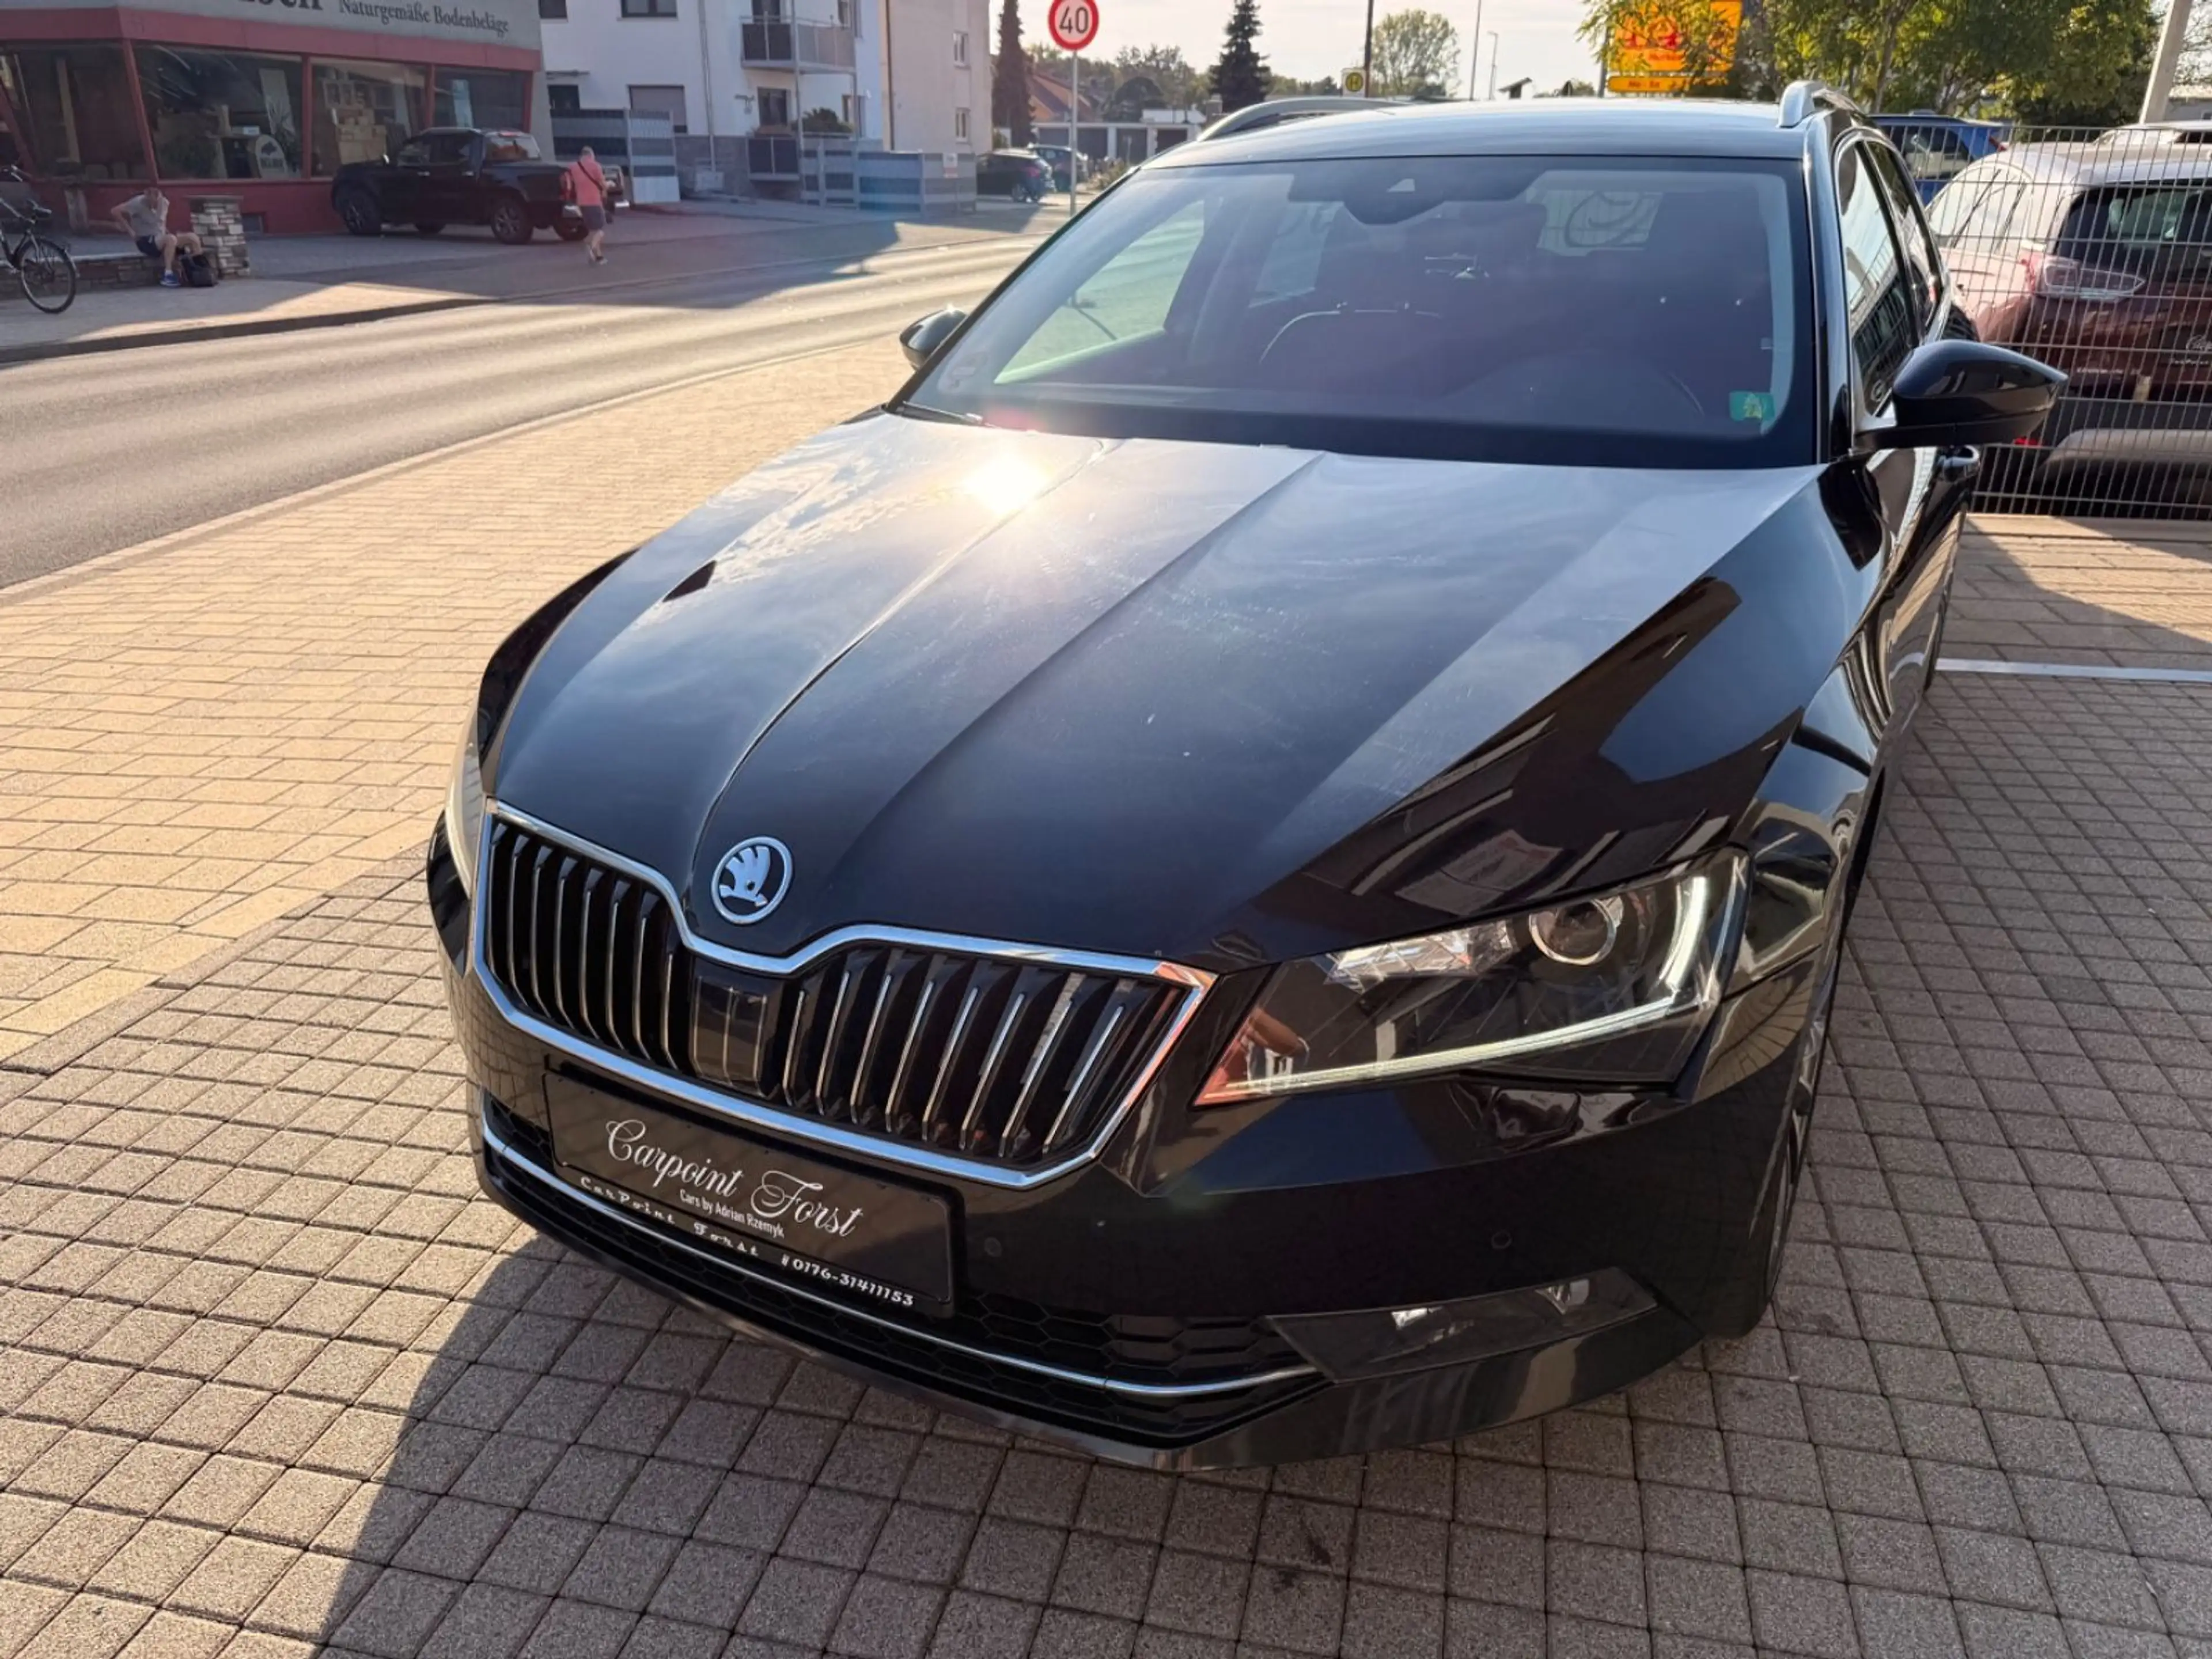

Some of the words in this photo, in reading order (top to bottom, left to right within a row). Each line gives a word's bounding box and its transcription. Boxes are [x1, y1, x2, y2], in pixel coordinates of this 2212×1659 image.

[434, 5, 509, 37] Bodenbeläge
[1059, 6, 1089, 33] 40
[606, 1119, 744, 1197] Carpoint
[750, 1170, 863, 1237] Forst
[680, 1188, 700, 1208] Cars
[701, 1196, 714, 1215] by
[714, 1202, 745, 1224] Adrian
